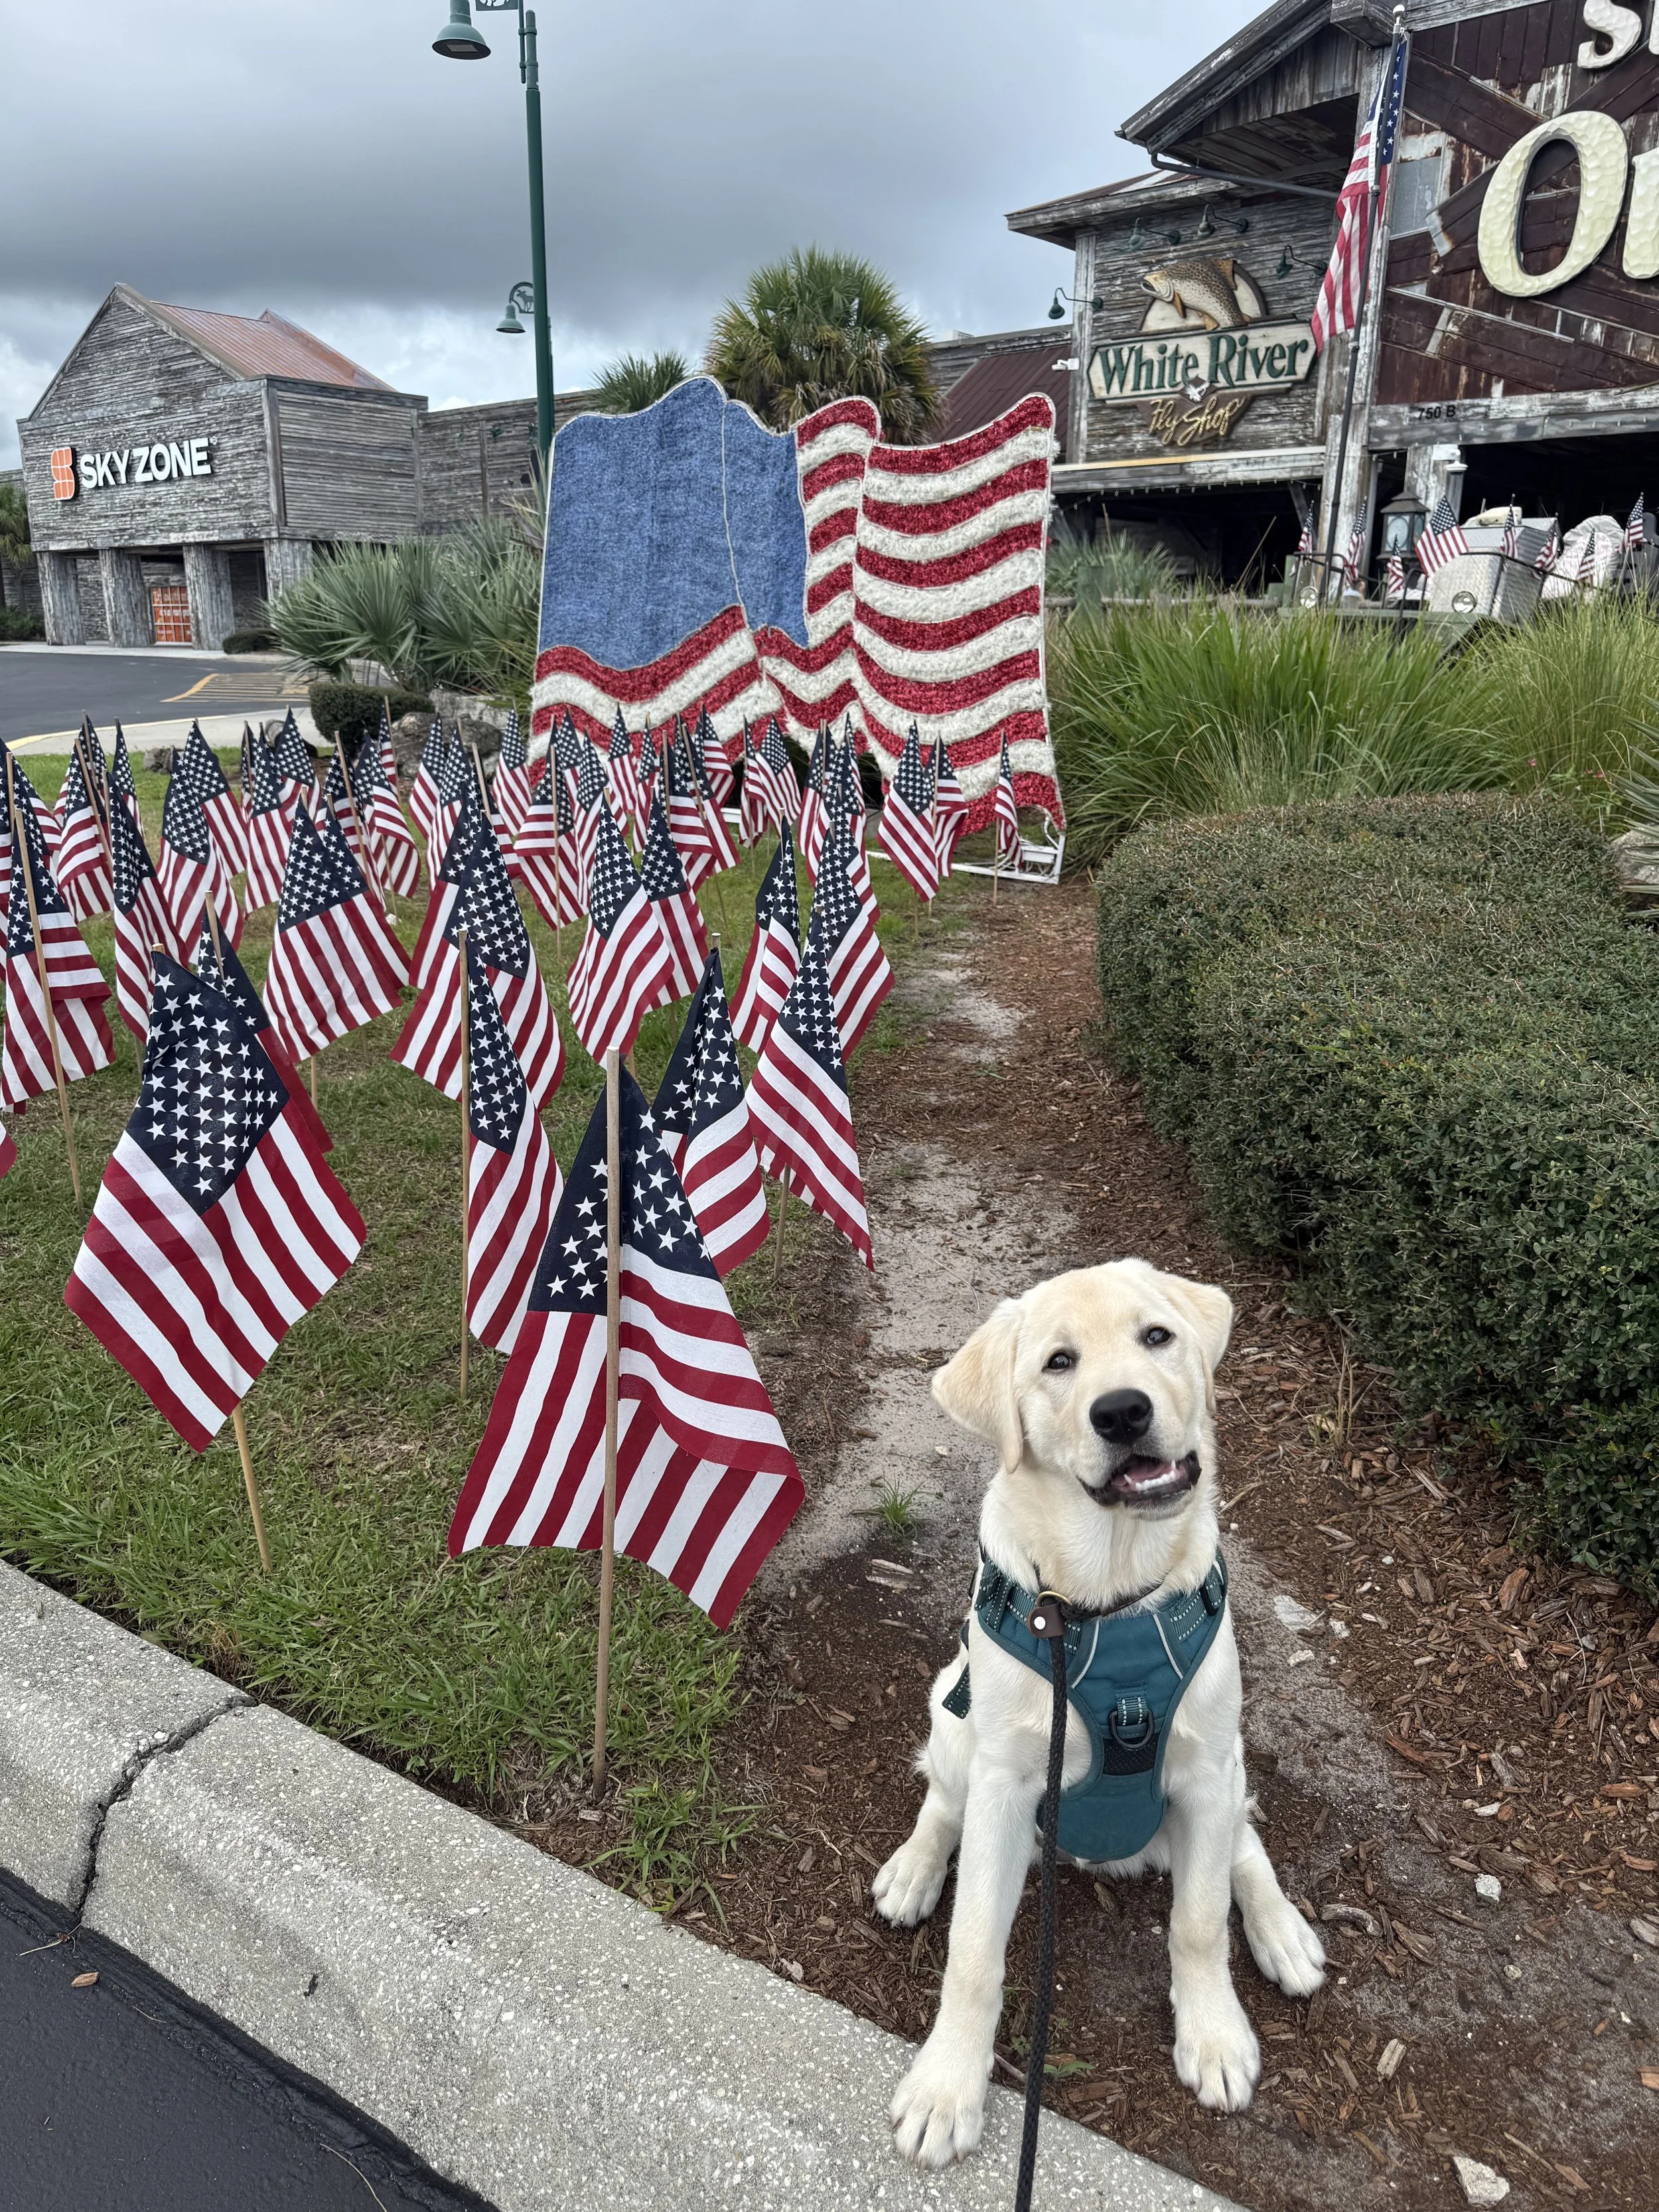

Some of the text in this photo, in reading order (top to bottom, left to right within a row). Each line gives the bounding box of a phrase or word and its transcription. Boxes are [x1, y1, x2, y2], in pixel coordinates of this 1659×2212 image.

[1577, 0, 1659, 68] S
[1098, 334, 1309, 394] White River
[1149, 396, 1247, 447] Fly Shop
[1417, 405, 1456, 420] 750 B
